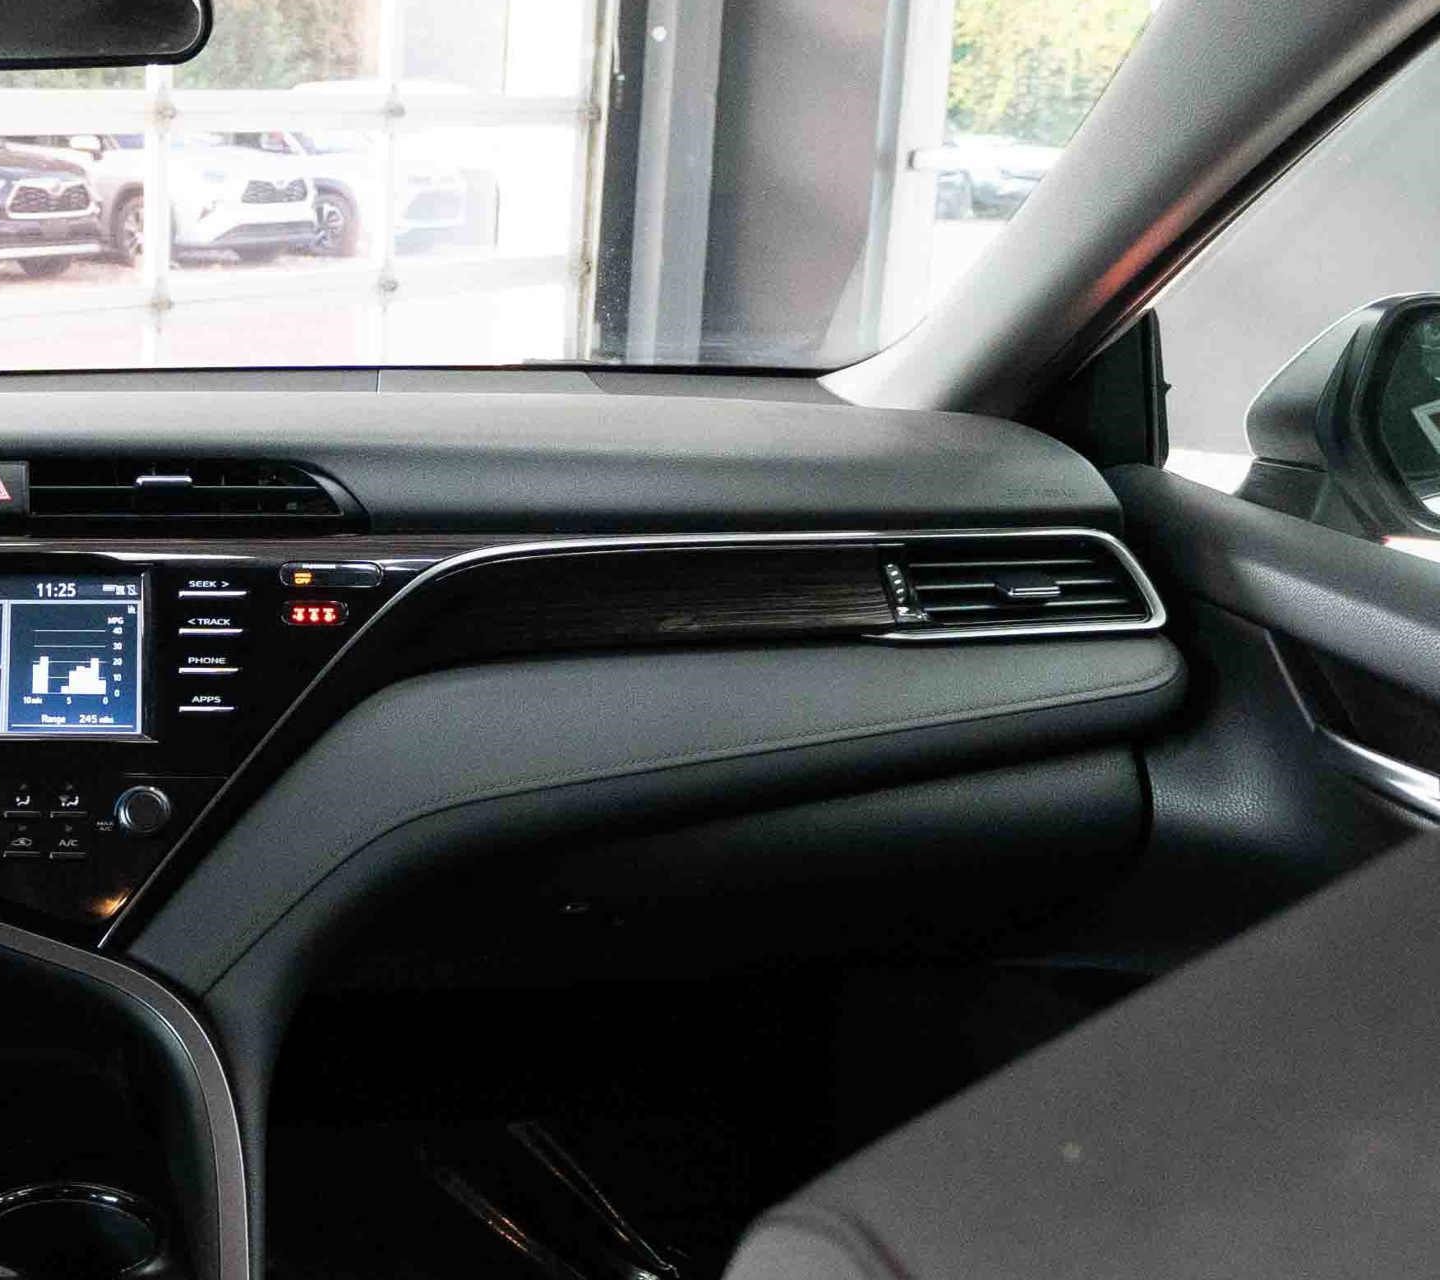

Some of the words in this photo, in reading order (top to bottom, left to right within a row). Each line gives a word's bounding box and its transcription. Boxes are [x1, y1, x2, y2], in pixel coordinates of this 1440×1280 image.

[188, 580, 217, 588] SEEK
[36, 583, 77, 597] 11:25
[197, 618, 230, 626] TRACK
[114, 689, 120, 698] 0
[103, 696, 109, 705] 0
[191, 695, 222, 703] APPS
[80, 714, 98, 724] 245
[59, 838, 79, 847] A/C
